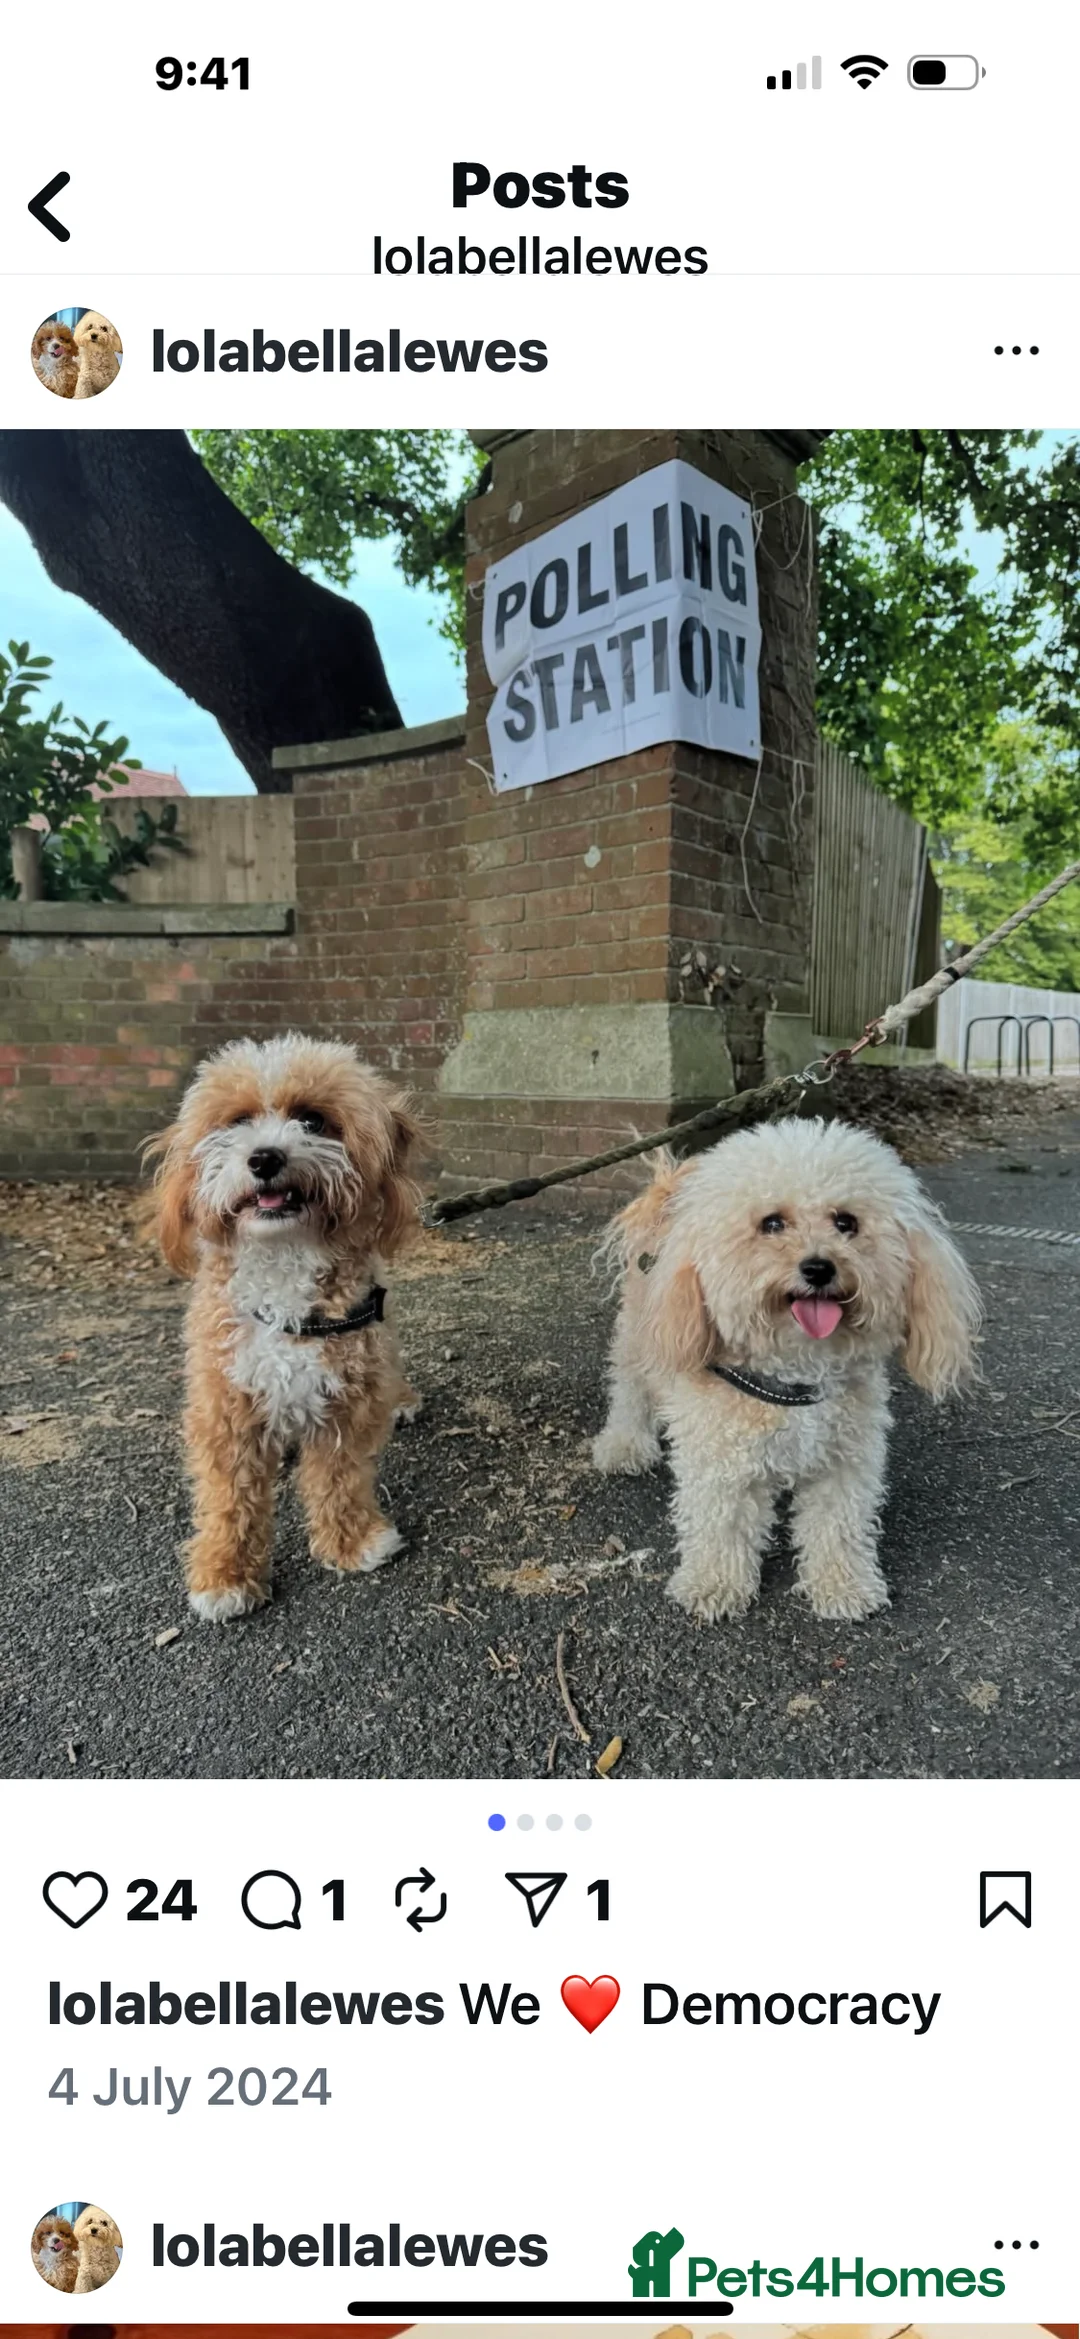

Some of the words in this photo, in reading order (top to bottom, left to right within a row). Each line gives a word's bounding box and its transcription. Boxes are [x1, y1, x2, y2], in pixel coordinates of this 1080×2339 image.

[155, 56, 250, 92] 9:41
[452, 162, 630, 210] Posts
[373, 236, 709, 275] lolabellalewes
[152, 328, 549, 374] lolabellalewes
[494, 501, 748, 652] POLLING
[503, 616, 746, 743] STATION
[126, 1878, 198, 1922] 24
[321, 1878, 345, 1922] 1
[586, 1878, 610, 1922] 1
[49, 1980, 445, 2026] lolabellalewes
[458, 1982, 541, 2026] We
[643, 1982, 942, 2036] Democracy
[48, 2067, 79, 2106] 4
[92, 2065, 192, 2115] July
[207, 2066, 332, 2107] 2024
[152, 2222, 549, 2268] lolabellalewes
